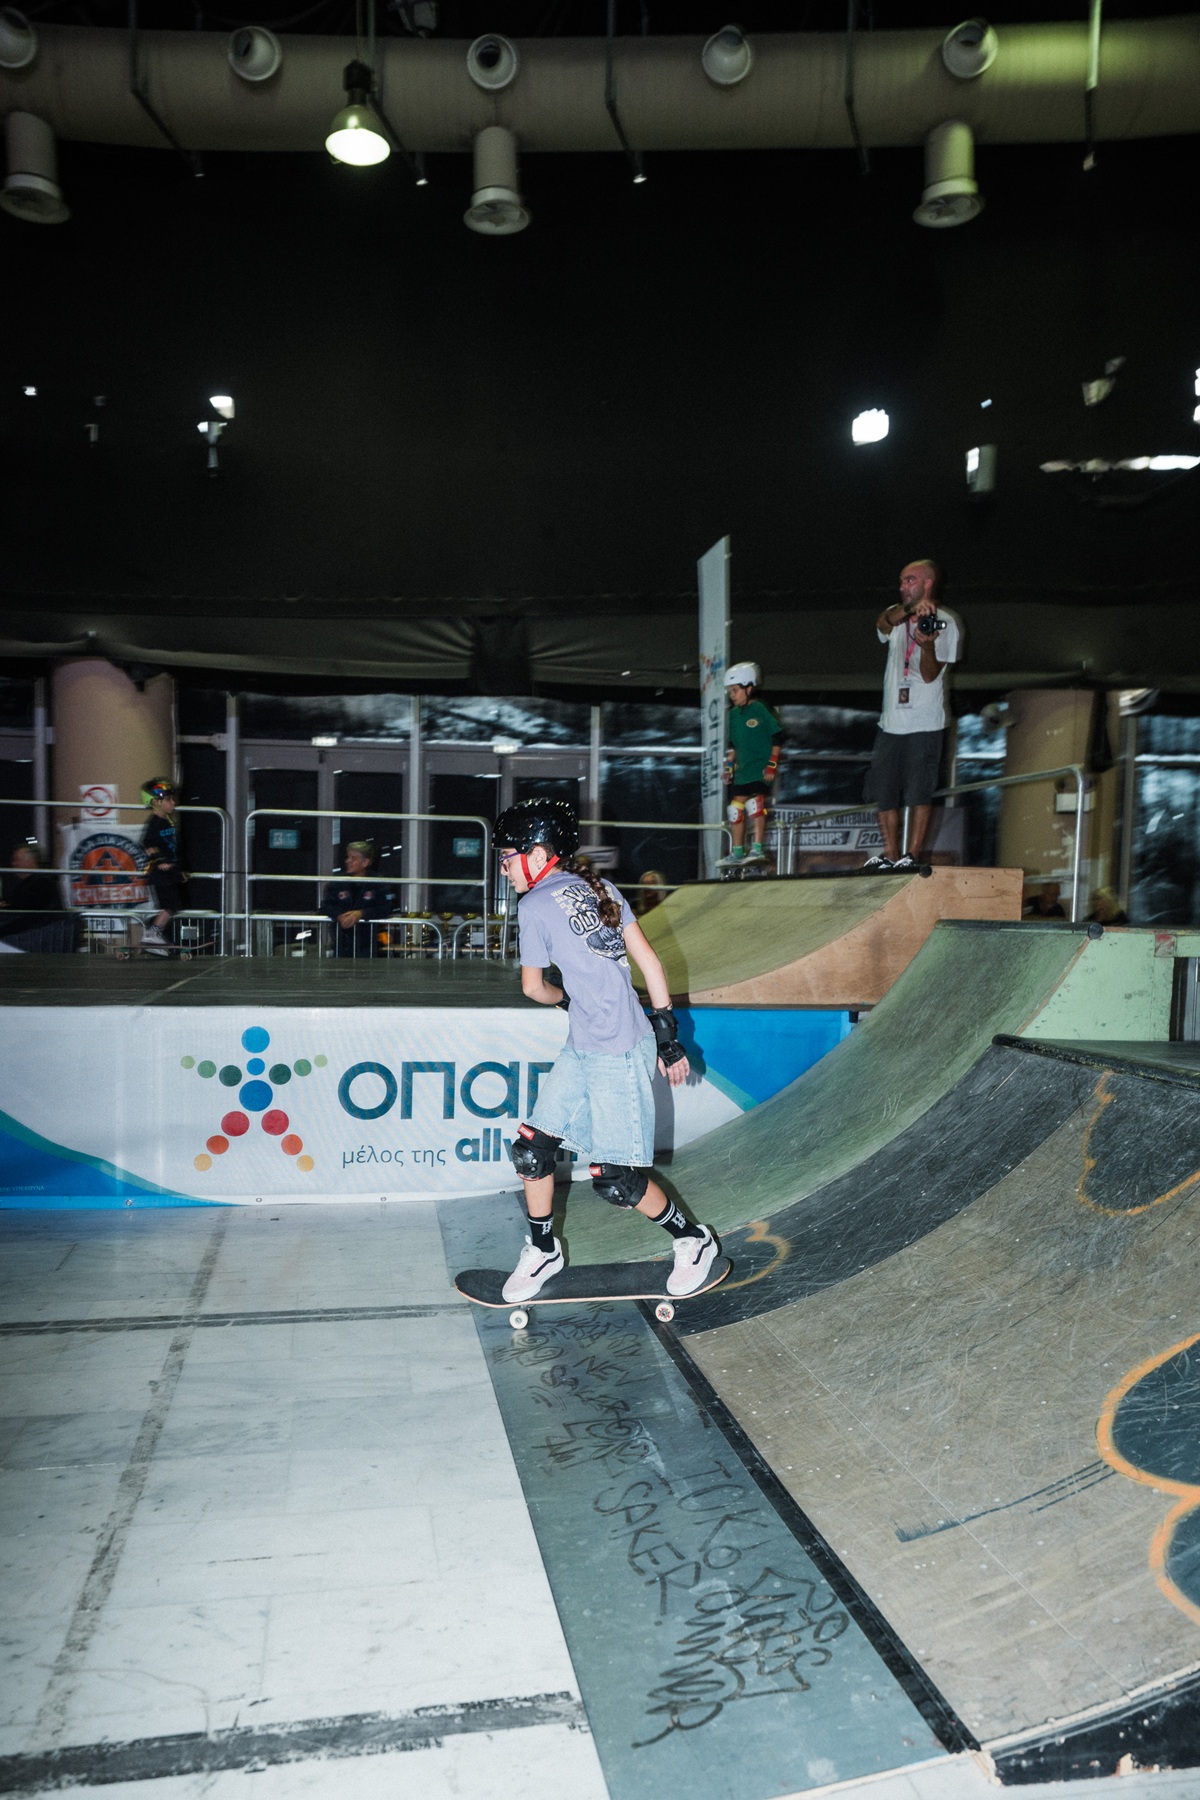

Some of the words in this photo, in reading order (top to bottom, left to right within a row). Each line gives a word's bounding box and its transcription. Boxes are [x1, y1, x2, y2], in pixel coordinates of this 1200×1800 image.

[569, 909, 601, 936] OLD
[342, 1145, 404, 1169] μέλος
[411, 1149, 447, 1167] της
